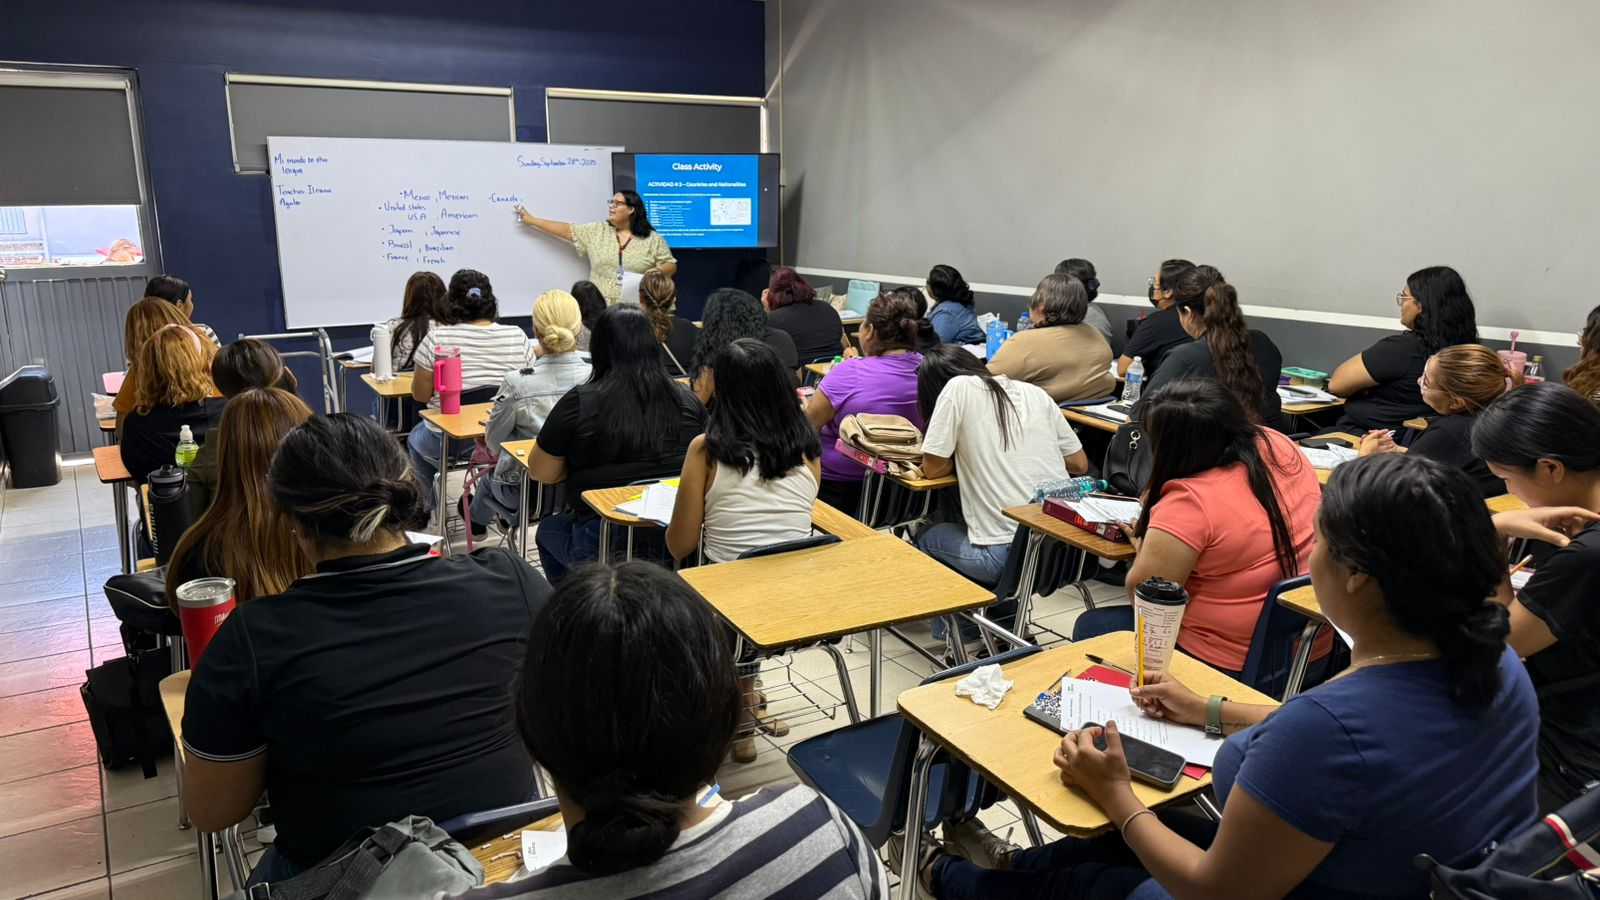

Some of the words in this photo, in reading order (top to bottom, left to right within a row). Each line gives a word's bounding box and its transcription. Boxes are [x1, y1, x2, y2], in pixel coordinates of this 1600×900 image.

[274, 152, 284, 164] Mi
[286, 156, 306, 164] mundo
[281, 166, 303, 176] lengua
[672, 162, 692, 171] Class
[693, 162, 722, 172] Activity
[438, 190, 469, 201] Mexican
[384, 201, 405, 211] United
[441, 208, 478, 219] American
[430, 225, 461, 236] Japanese
[424, 243, 455, 252] Brazilian
[423, 256, 446, 264] French
